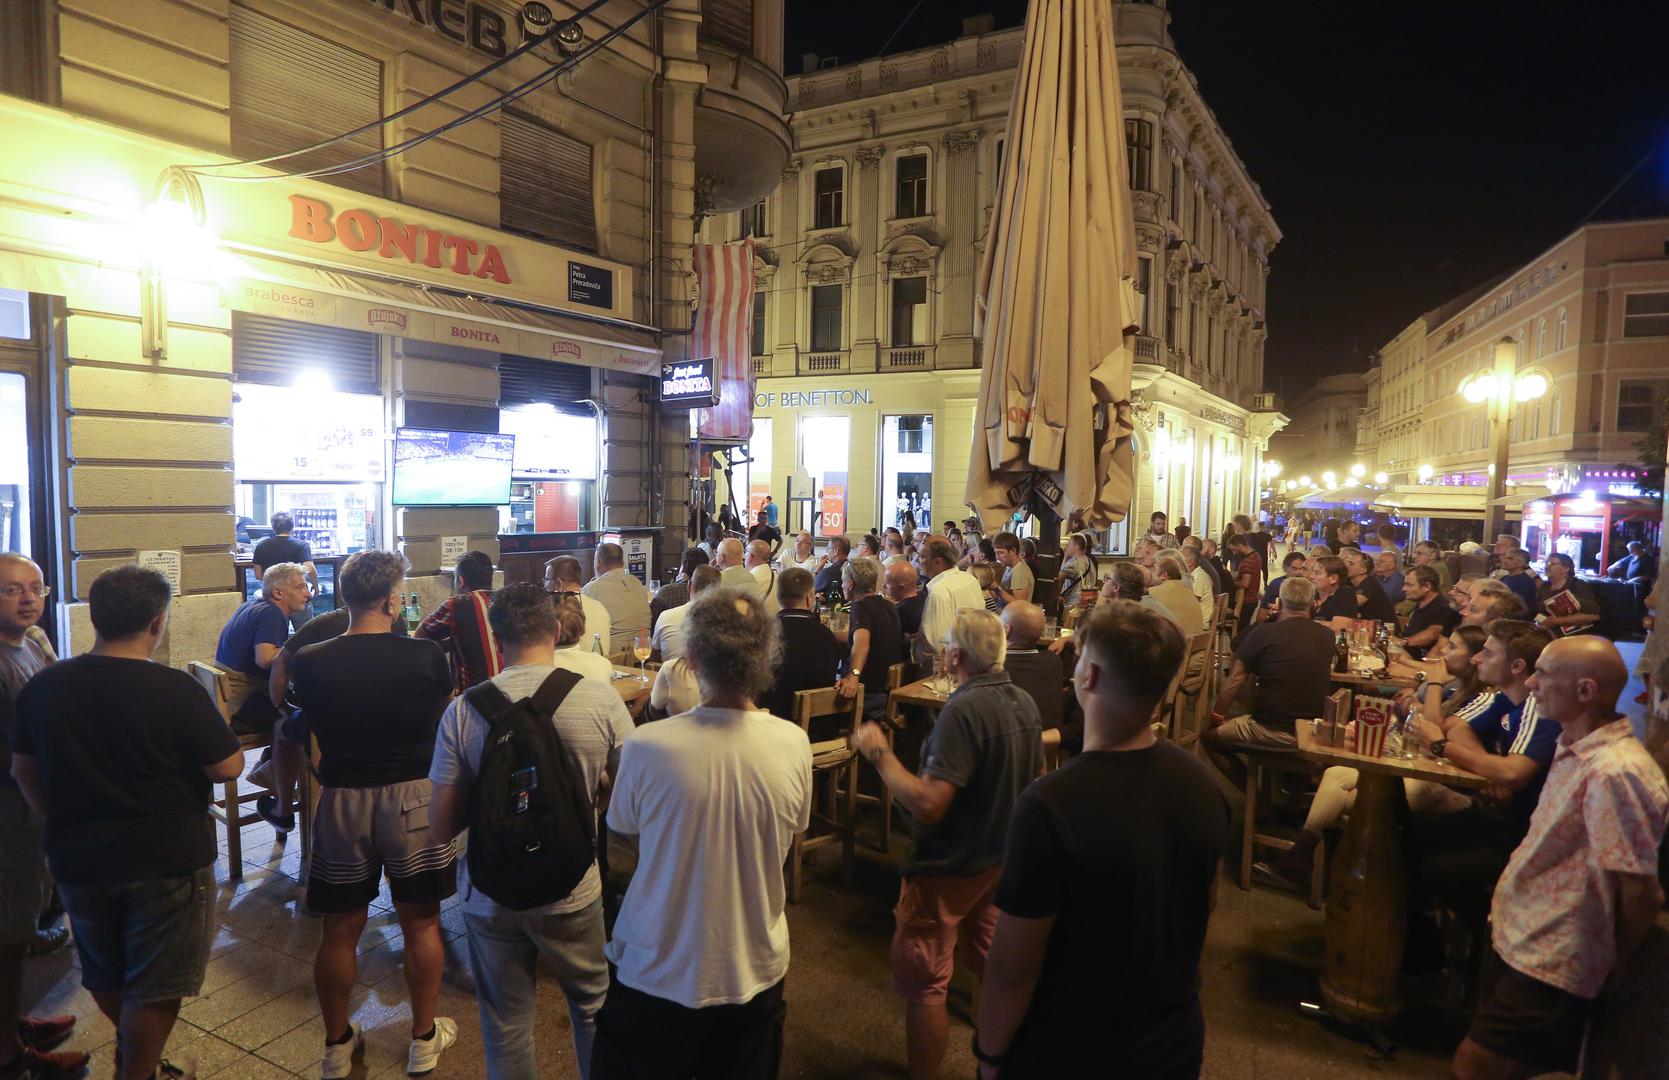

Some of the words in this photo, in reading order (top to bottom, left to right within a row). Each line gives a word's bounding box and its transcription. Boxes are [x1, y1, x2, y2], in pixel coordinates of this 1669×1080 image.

[288, 194, 512, 285] BONITA
[573, 270, 586, 279] Petra
[245, 287, 315, 308] arabesca
[450, 326, 500, 344] BONITA
[663, 376, 712, 396] BONITA
[755, 392, 775, 408] OF
[294, 457, 308, 468] 15
